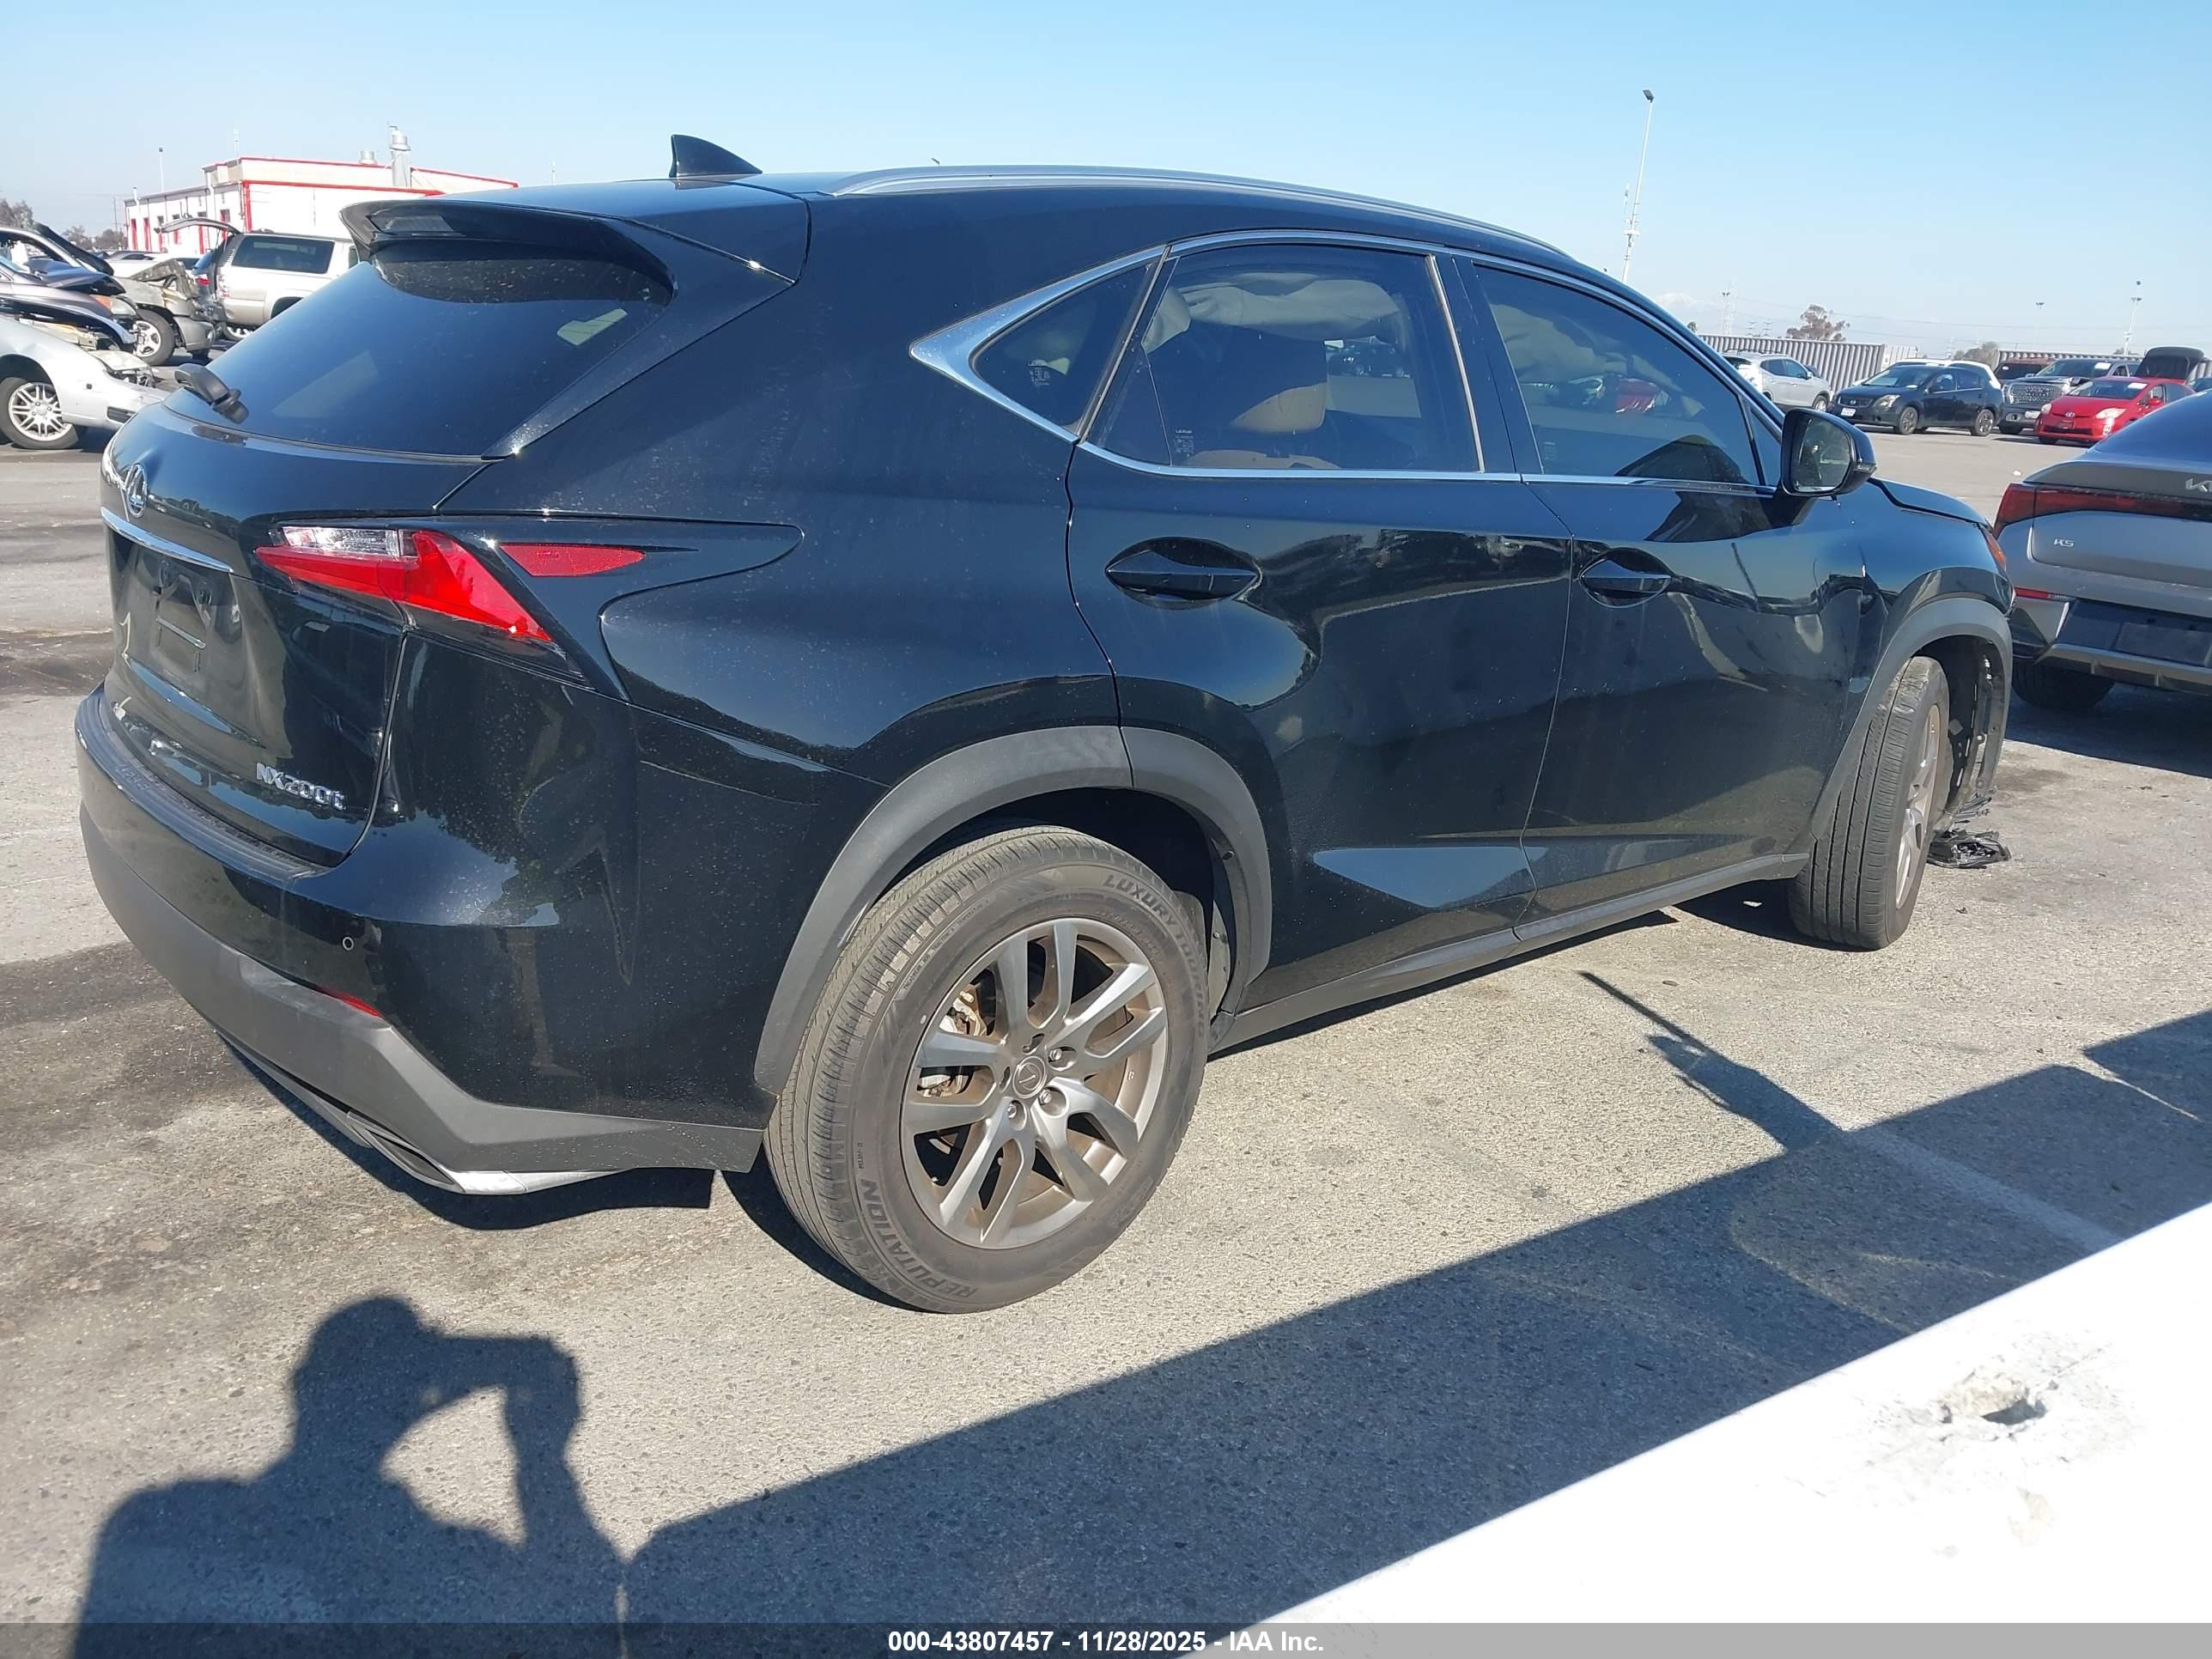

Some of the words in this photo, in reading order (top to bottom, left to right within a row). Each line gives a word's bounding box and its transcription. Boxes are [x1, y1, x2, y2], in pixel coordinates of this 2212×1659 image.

[2053, 538, 2075, 547] K5
[256, 762, 347, 811] NX200t
[1103, 874, 1177, 927] LUXURY
[860, 1176, 978, 1298] REPUTATION
